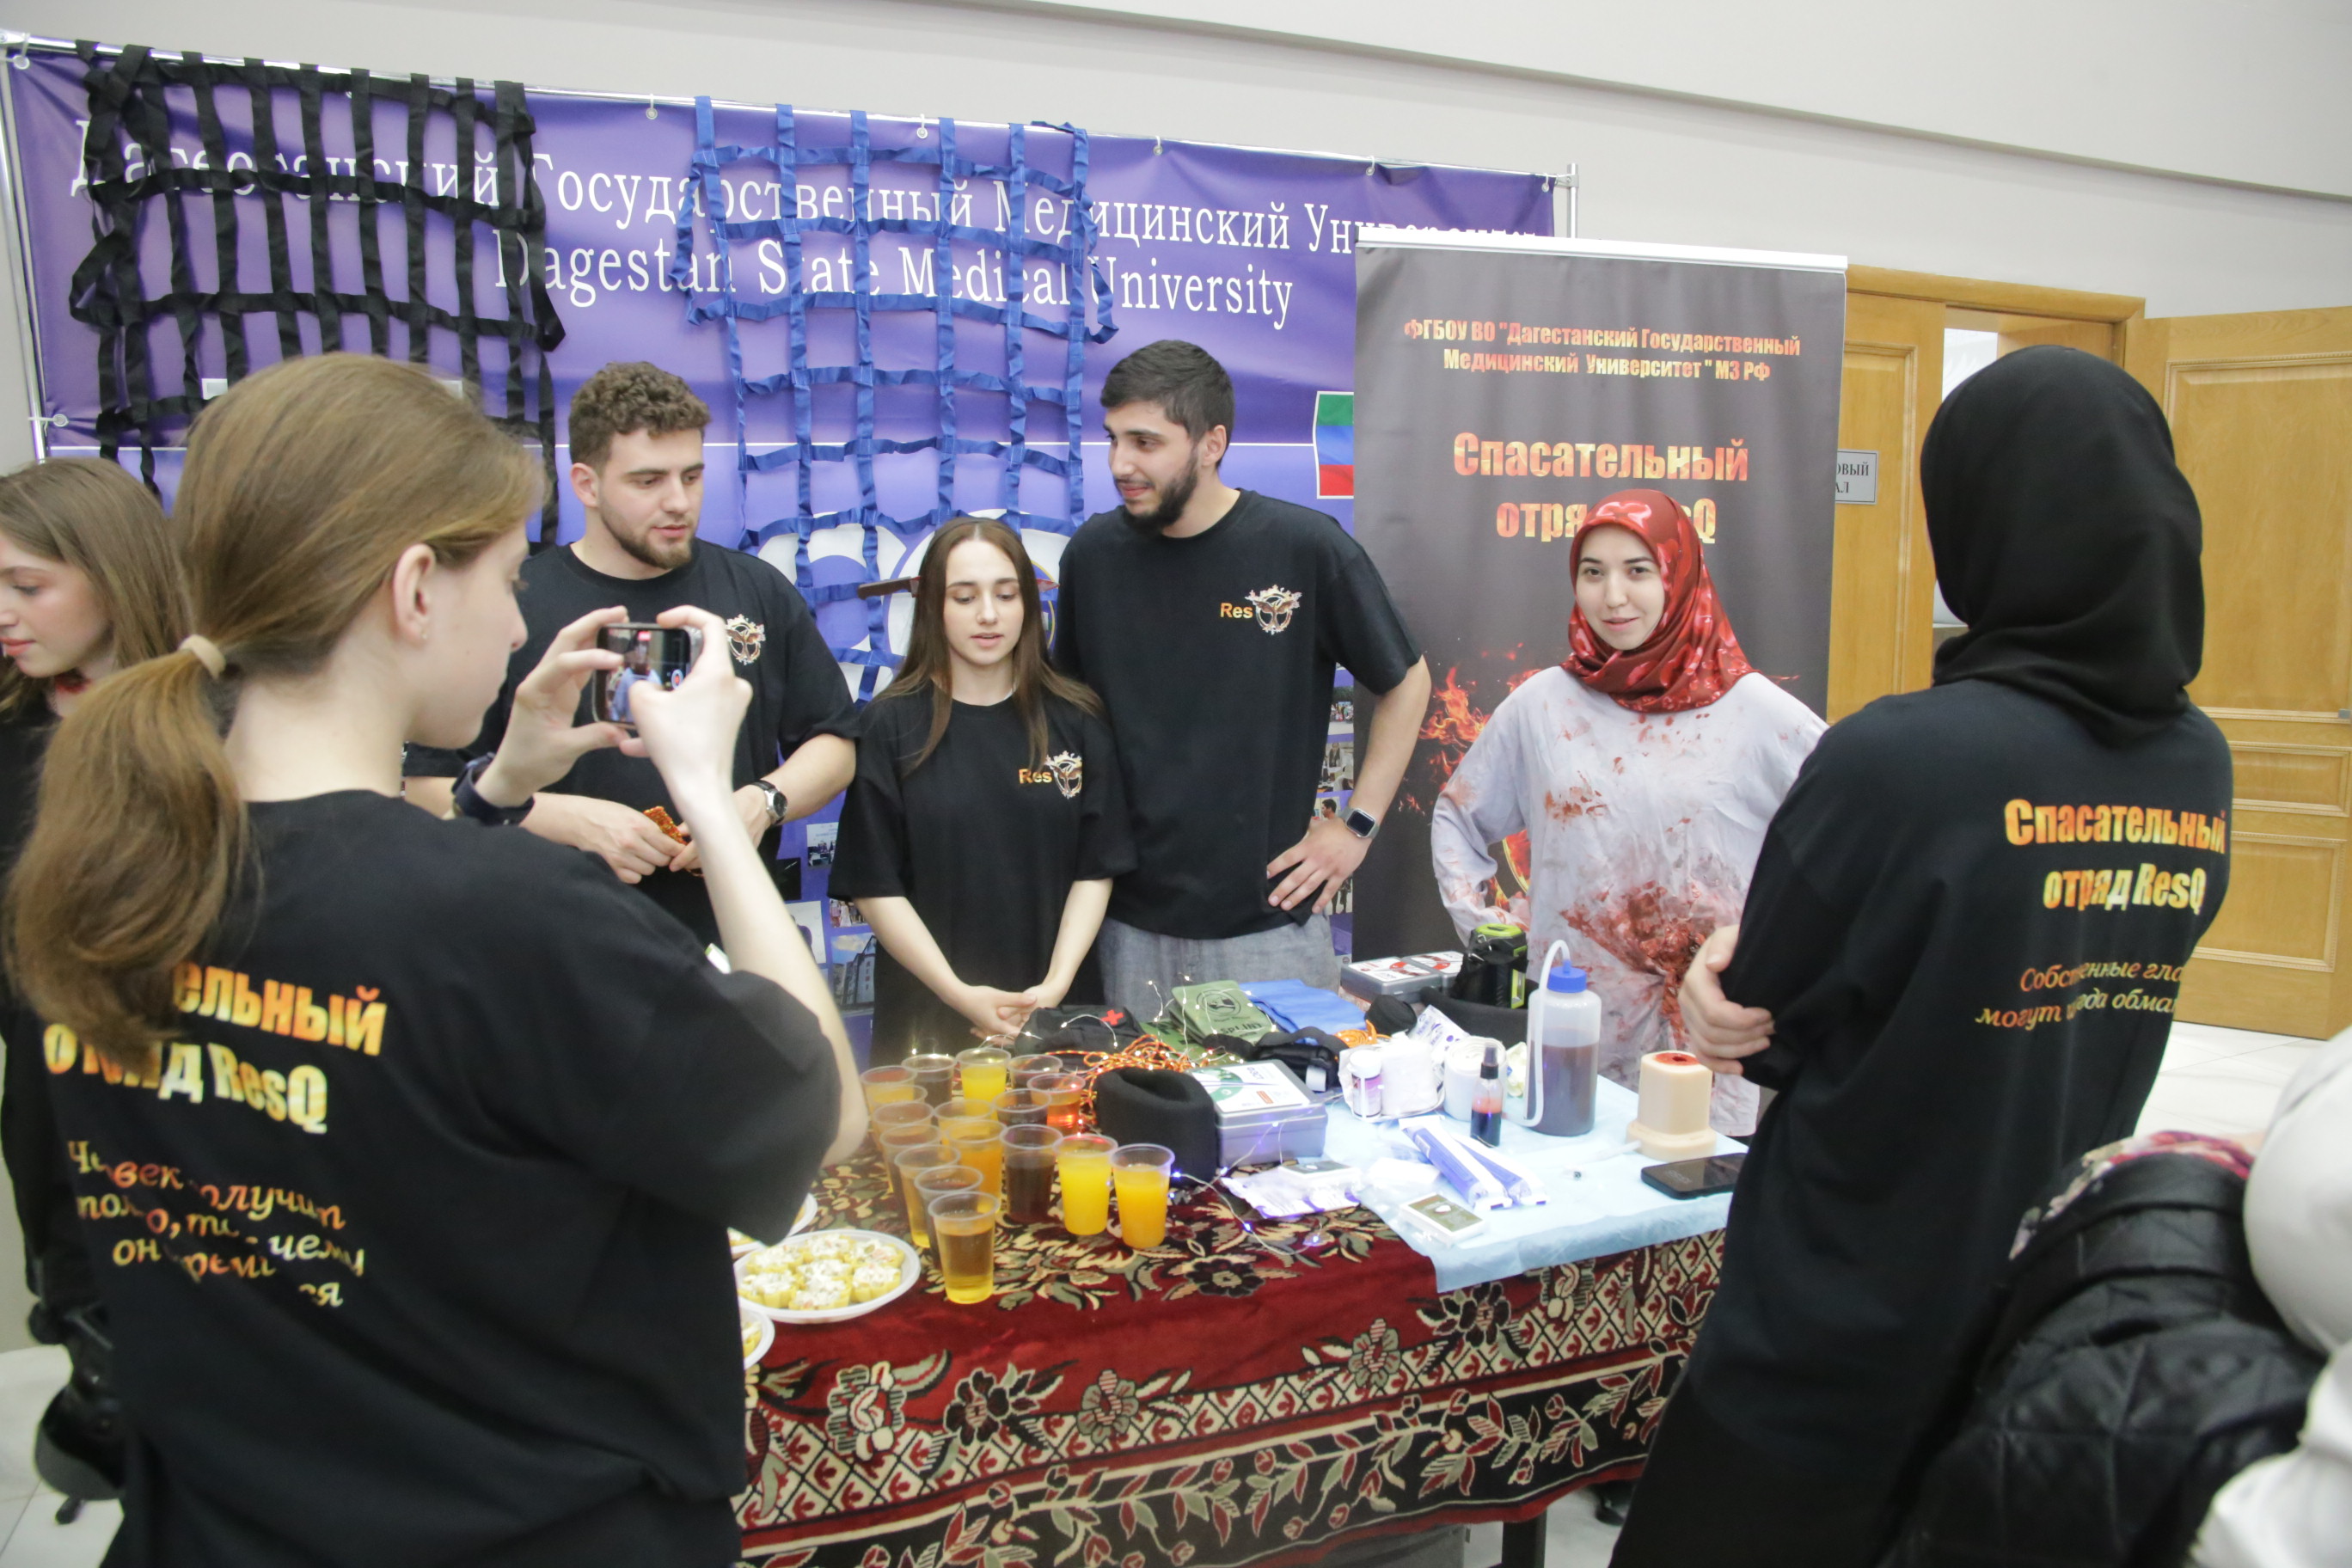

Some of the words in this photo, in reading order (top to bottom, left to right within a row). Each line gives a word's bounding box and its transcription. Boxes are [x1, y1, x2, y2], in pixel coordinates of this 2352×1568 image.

[1087, 255, 1293, 330] University
[1404, 319, 1468, 341] ФГБОУ
[1471, 321, 1496, 342] ВО
[1641, 328, 1800, 356] Государственный
[1443, 348, 1579, 374] Медицинский
[1715, 360, 1740, 380] МЗ
[1454, 432, 1749, 481] Спасательный
[1496, 501, 1588, 542] отря
[2004, 799, 2226, 854] Спасательный
[2043, 869, 2134, 911] отряд
[2132, 862, 2207, 916] ResQ
[1975, 1005, 2062, 1032] могут
[207, 1042, 328, 1134] ResQ
